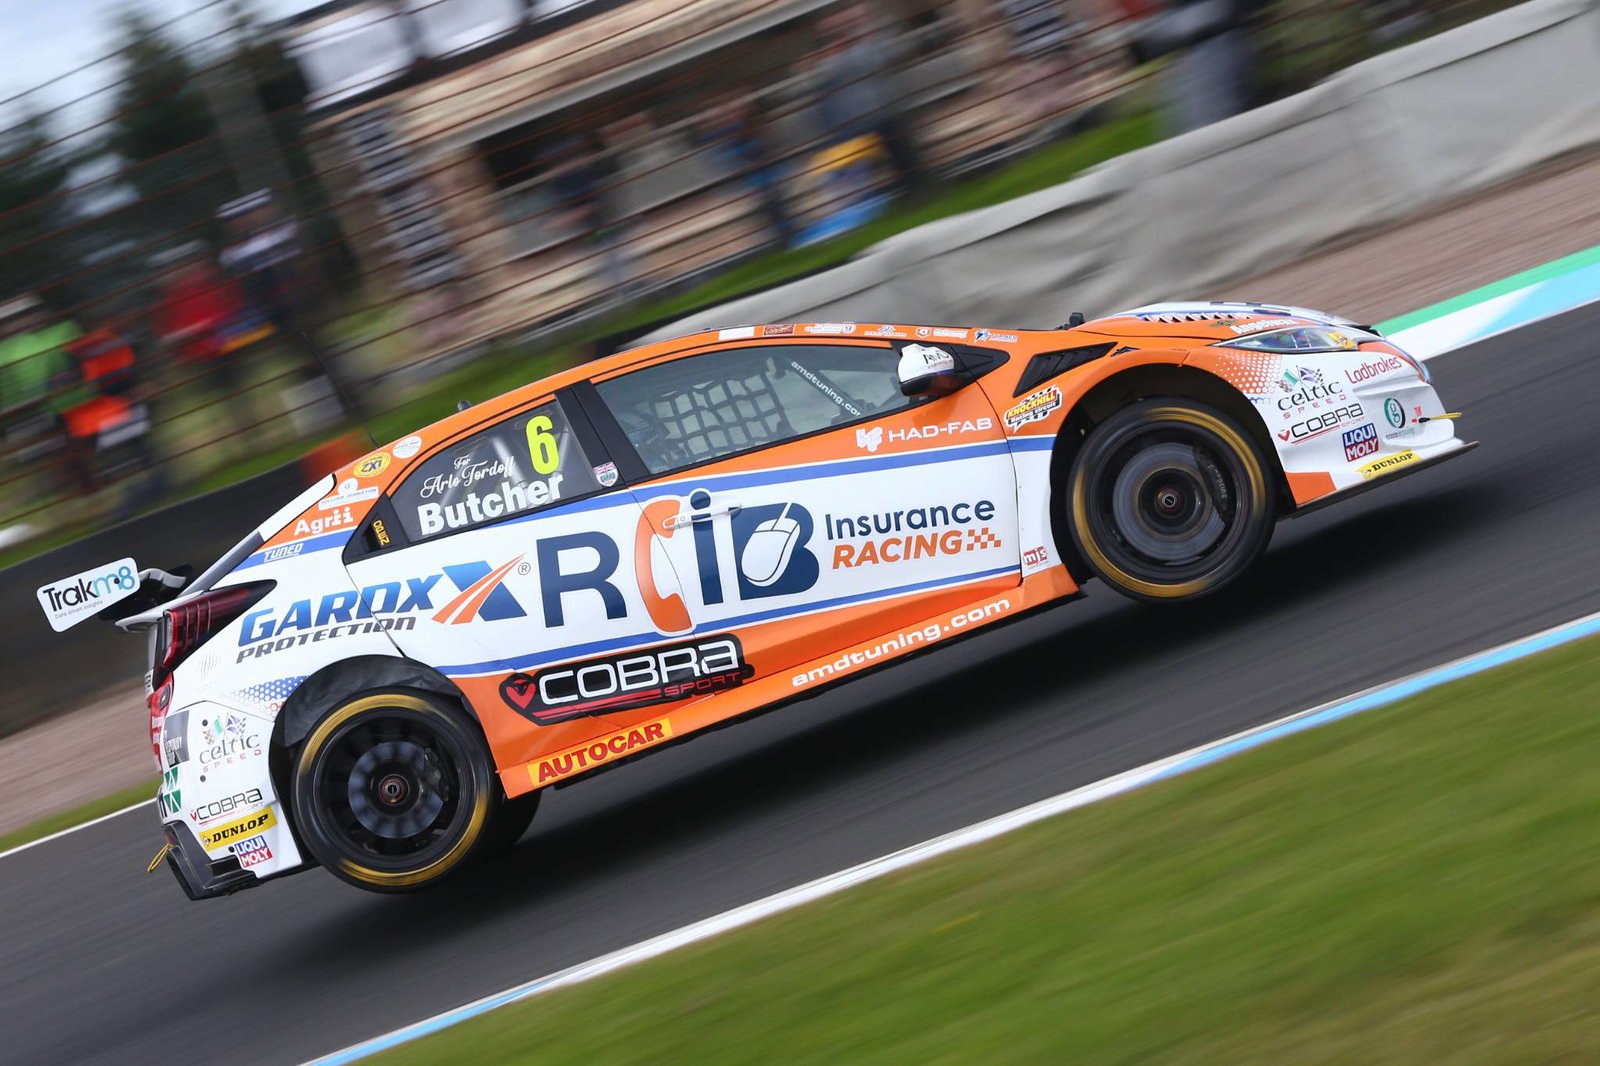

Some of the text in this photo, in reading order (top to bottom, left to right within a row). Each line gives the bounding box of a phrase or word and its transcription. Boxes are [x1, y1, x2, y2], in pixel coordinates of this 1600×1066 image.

[1345, 357, 1402, 384] Ladbrokes
[1007, 391, 1056, 418] KNOCKHILL
[1283, 394, 1346, 419] SPEED
[888, 418, 993, 442] HAD-FAB
[1343, 424, 1376, 447] LIQUI
[526, 415, 560, 475] 6
[1346, 438, 1378, 461] MOLY
[454, 454, 471, 470] For
[1372, 452, 1413, 472] DUNLOP
[420, 456, 516, 498] Arlo Tordoff
[417, 474, 564, 536] Butcher
[825, 500, 995, 540] Insurance
[263, 543, 304, 562] TUNED
[832, 530, 963, 570] RACING
[43, 566, 136, 612] Trakm8
[54, 612, 67, 620] Data
[236, 616, 417, 664] PROTECTION
[791, 599, 1011, 687] amdtuning.com
[664, 672, 740, 697] SPORT
[202, 749, 262, 773] SPEED
[537, 722, 665, 783] AUTOCAR
[212, 813, 269, 843] DUNLOP
[235, 836, 267, 855] LIQUI
[240, 847, 270, 867] MOLY
